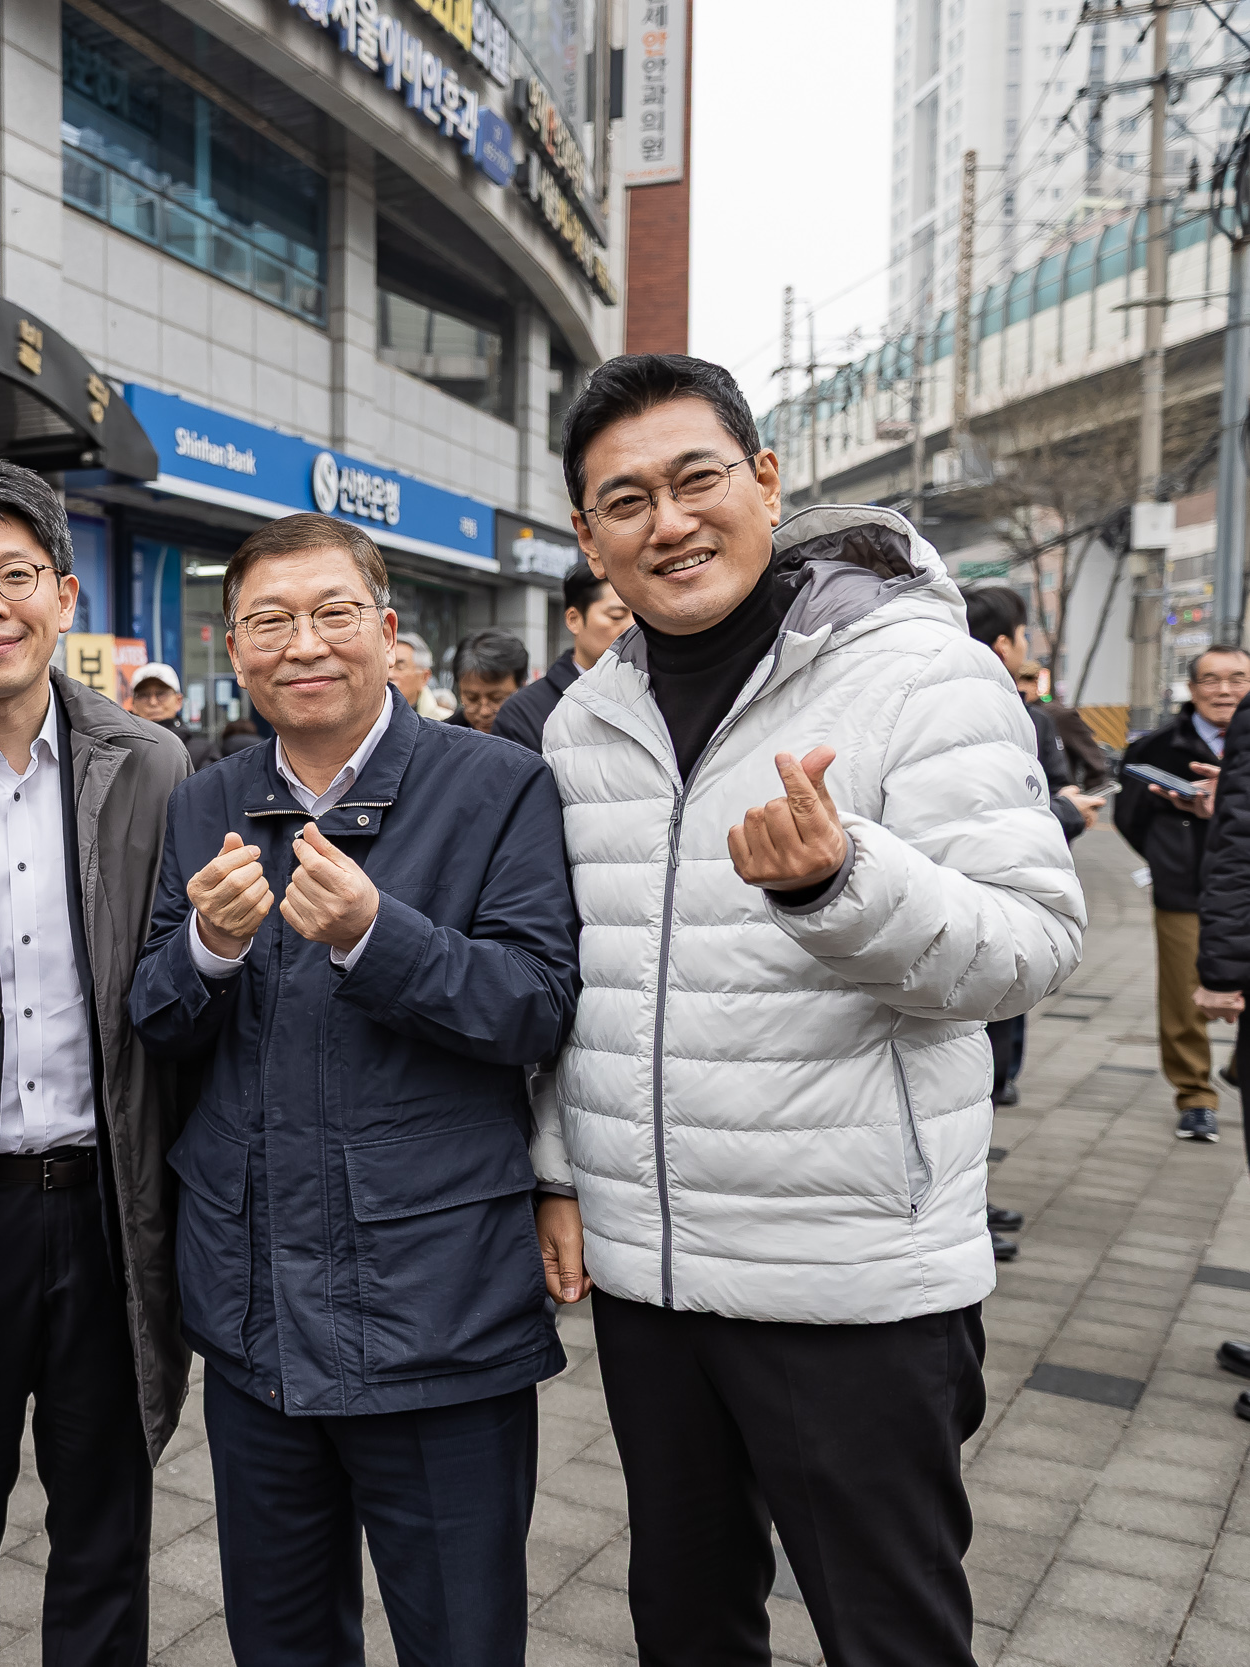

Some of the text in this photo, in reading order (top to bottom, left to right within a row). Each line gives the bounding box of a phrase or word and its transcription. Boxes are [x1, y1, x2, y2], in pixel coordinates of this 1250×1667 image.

[175, 427, 257, 476] Shinhan Bank
[339, 466, 400, 526] 신한은행
